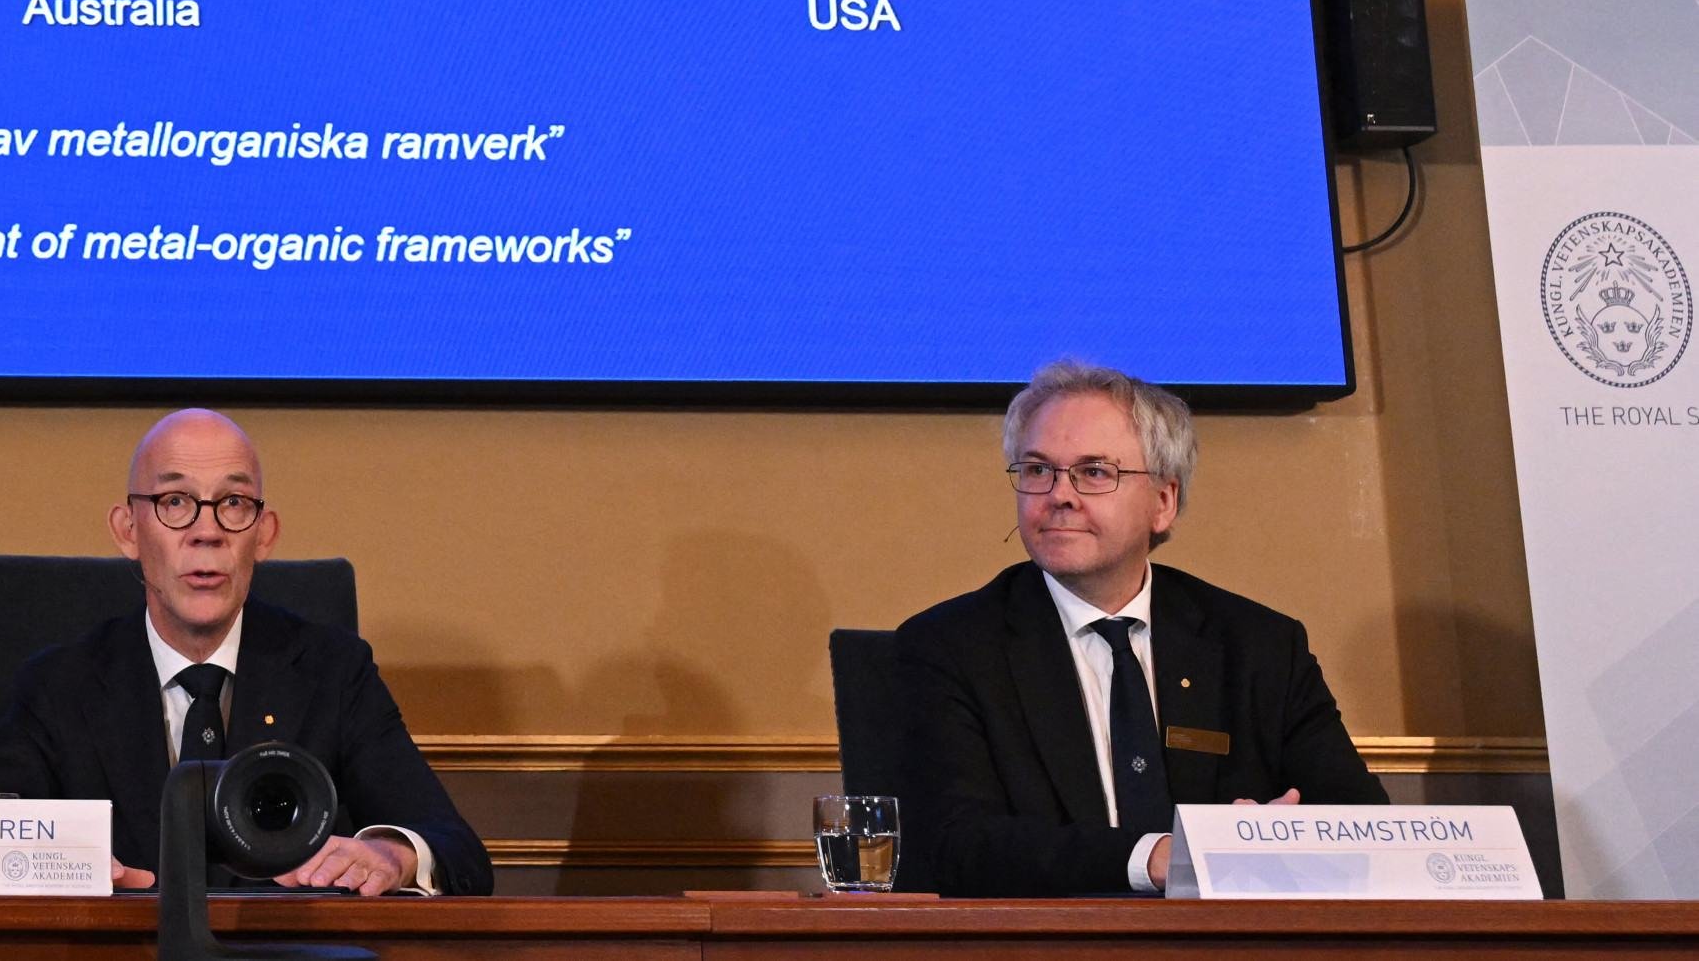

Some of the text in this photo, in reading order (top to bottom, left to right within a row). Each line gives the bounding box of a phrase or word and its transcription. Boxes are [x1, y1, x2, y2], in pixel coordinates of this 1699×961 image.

[48, 122, 368, 166] metallorganiska
[32, 224, 77, 259] of
[83, 225, 364, 270] metal-organic
[1560, 407, 1605, 425] THE
[1612, 407, 1681, 425] ROYAL
[1237, 816, 1473, 841] OLOF RAMSTRÖM
